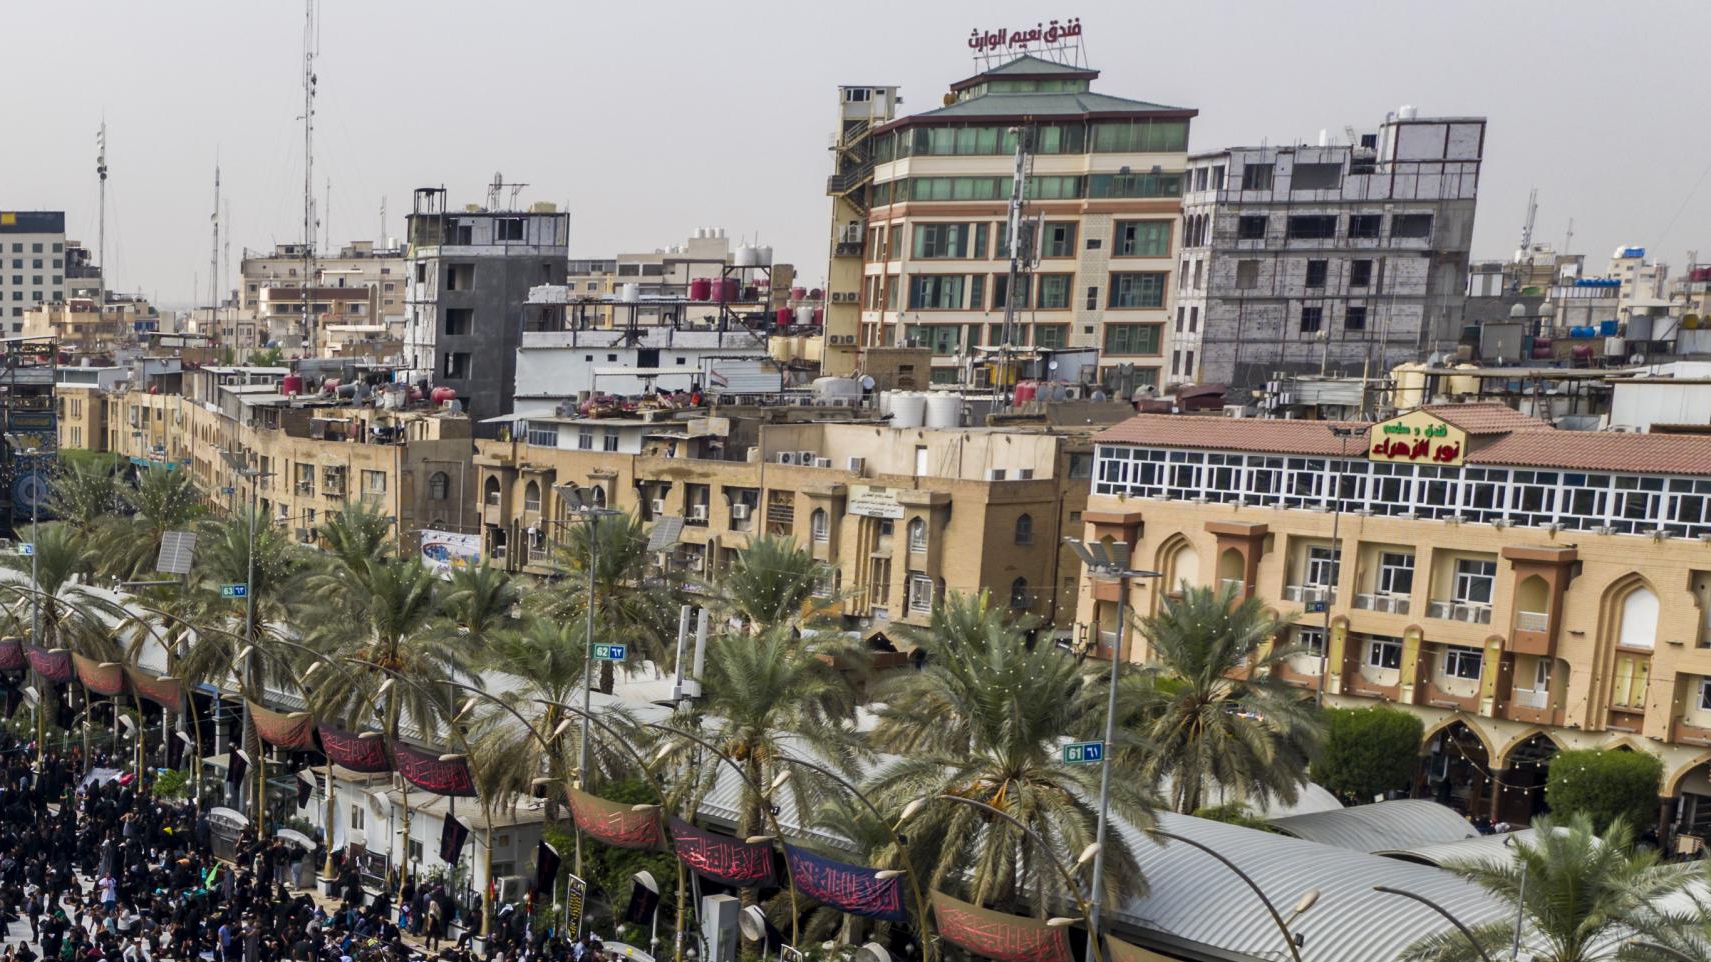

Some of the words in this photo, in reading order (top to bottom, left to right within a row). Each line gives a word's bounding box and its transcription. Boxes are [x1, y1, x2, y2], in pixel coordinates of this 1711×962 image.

[1008, 23, 1043, 49] نعيم
[1043, 17, 1082, 43] فندق
[968, 28, 1007, 52] الوارث
[1383, 421, 1411, 435] مطعم
[1413, 426, 1421, 436] و
[1424, 423, 1448, 438] فندق
[1371, 437, 1430, 460] الزهراء
[1432, 440, 1460, 463] نور
[223, 587, 233, 595] 63
[596, 646, 609, 657] 62
[1068, 747, 1082, 760] 61
[1086, 747, 1099, 758] ٦١
